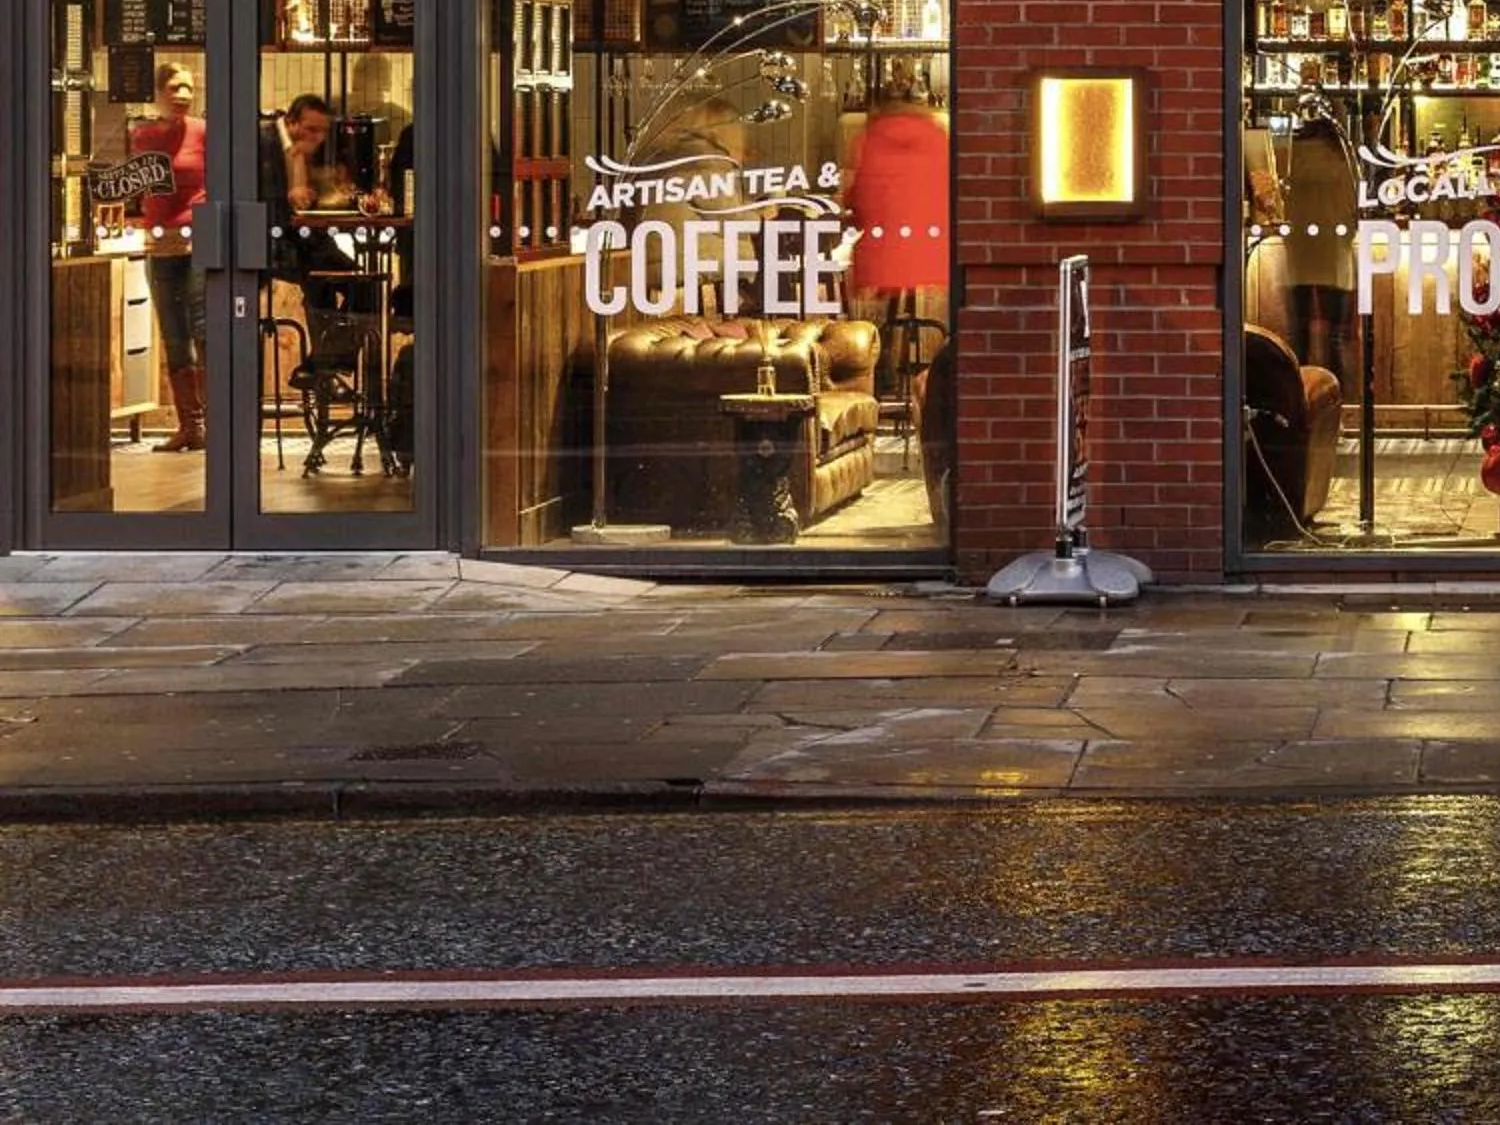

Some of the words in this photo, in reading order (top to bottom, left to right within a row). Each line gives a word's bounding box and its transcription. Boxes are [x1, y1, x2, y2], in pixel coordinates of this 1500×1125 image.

[97, 162, 165, 200] CLOSED
[587, 173, 735, 211] ARTISAN
[743, 165, 811, 195] TEA
[817, 161, 841, 188] &
[584, 219, 842, 316] COFFEE
